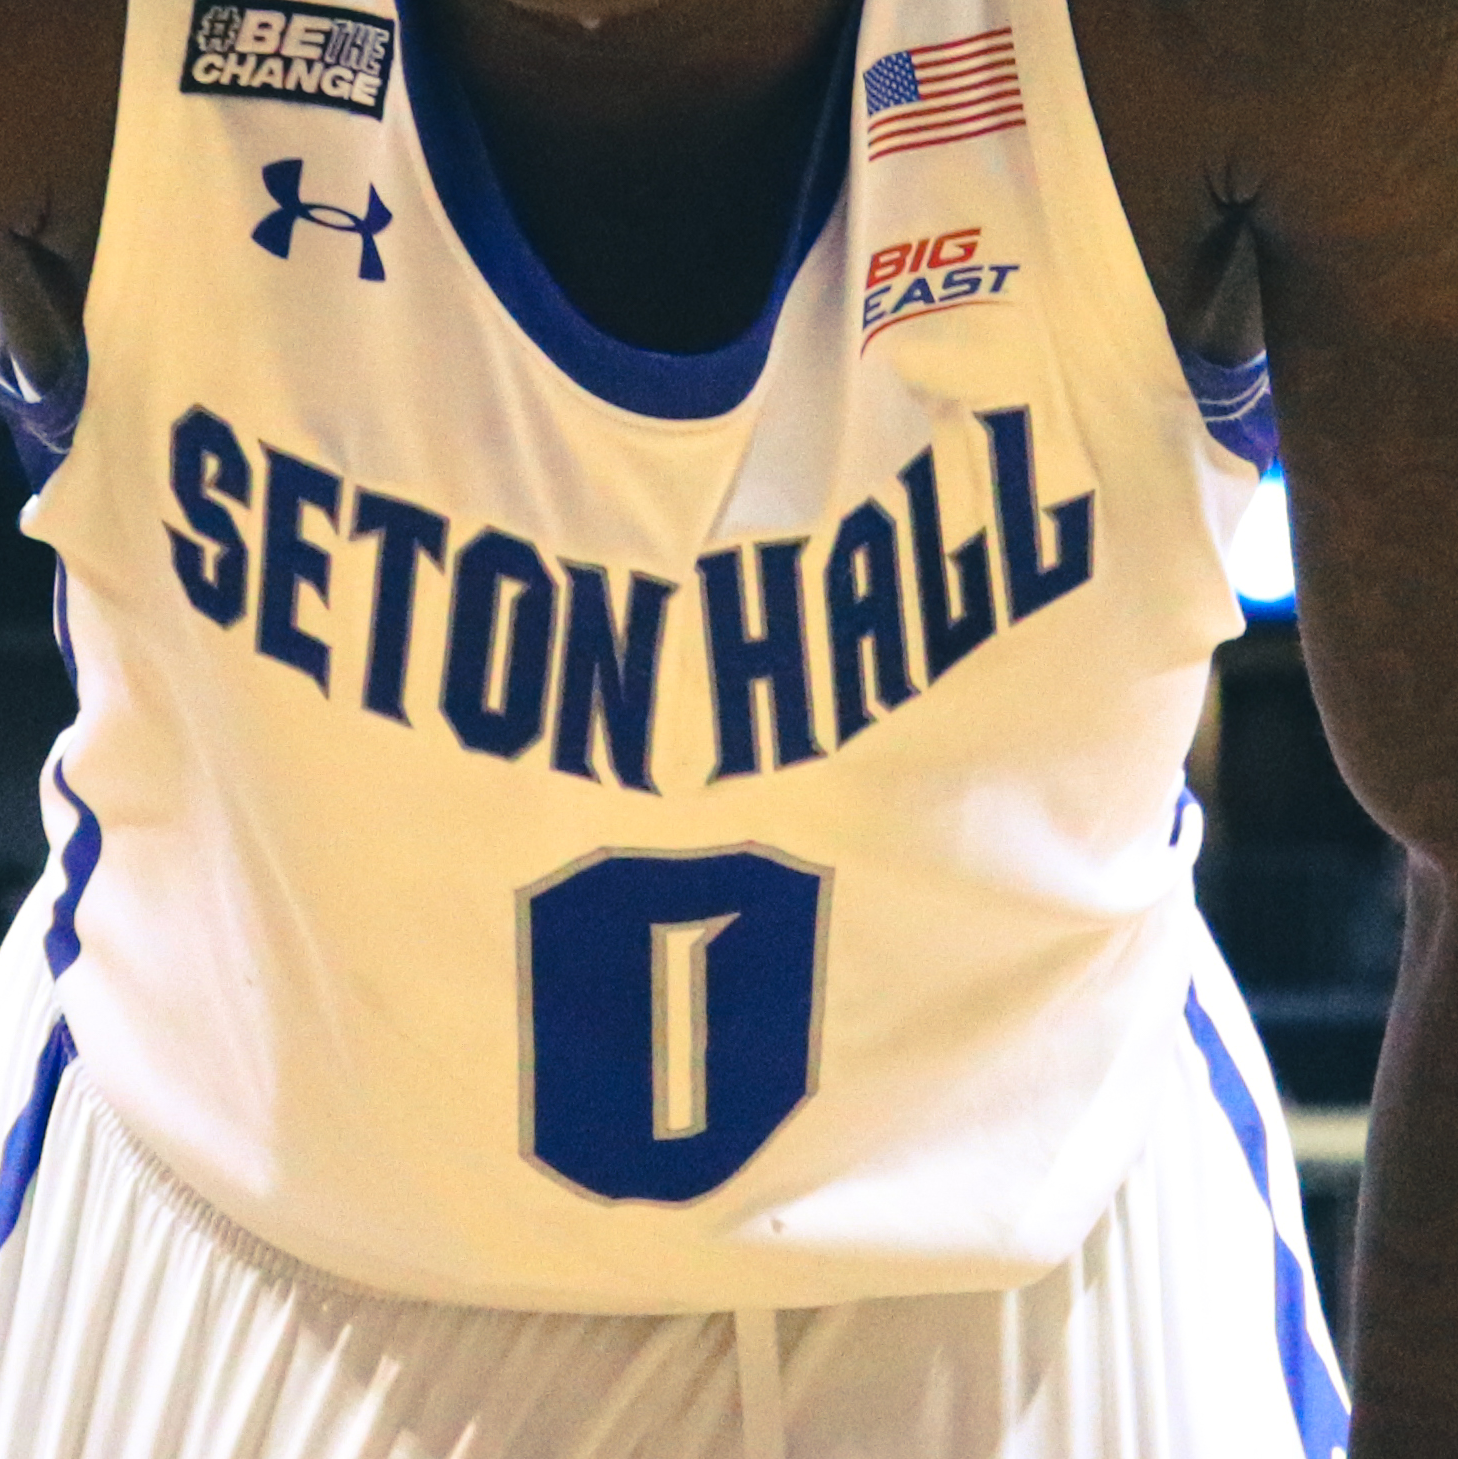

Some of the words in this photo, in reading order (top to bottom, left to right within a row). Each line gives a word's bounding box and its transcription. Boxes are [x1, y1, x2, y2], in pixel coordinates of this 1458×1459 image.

[192, 53, 383, 107] CHANGE
[866, 227, 981, 290] BIG
[863, 265, 1020, 330] EAST
[162, 404, 680, 797] SETON
[697, 404, 1095, 786] HALL
[514, 840, 835, 1208] 0
